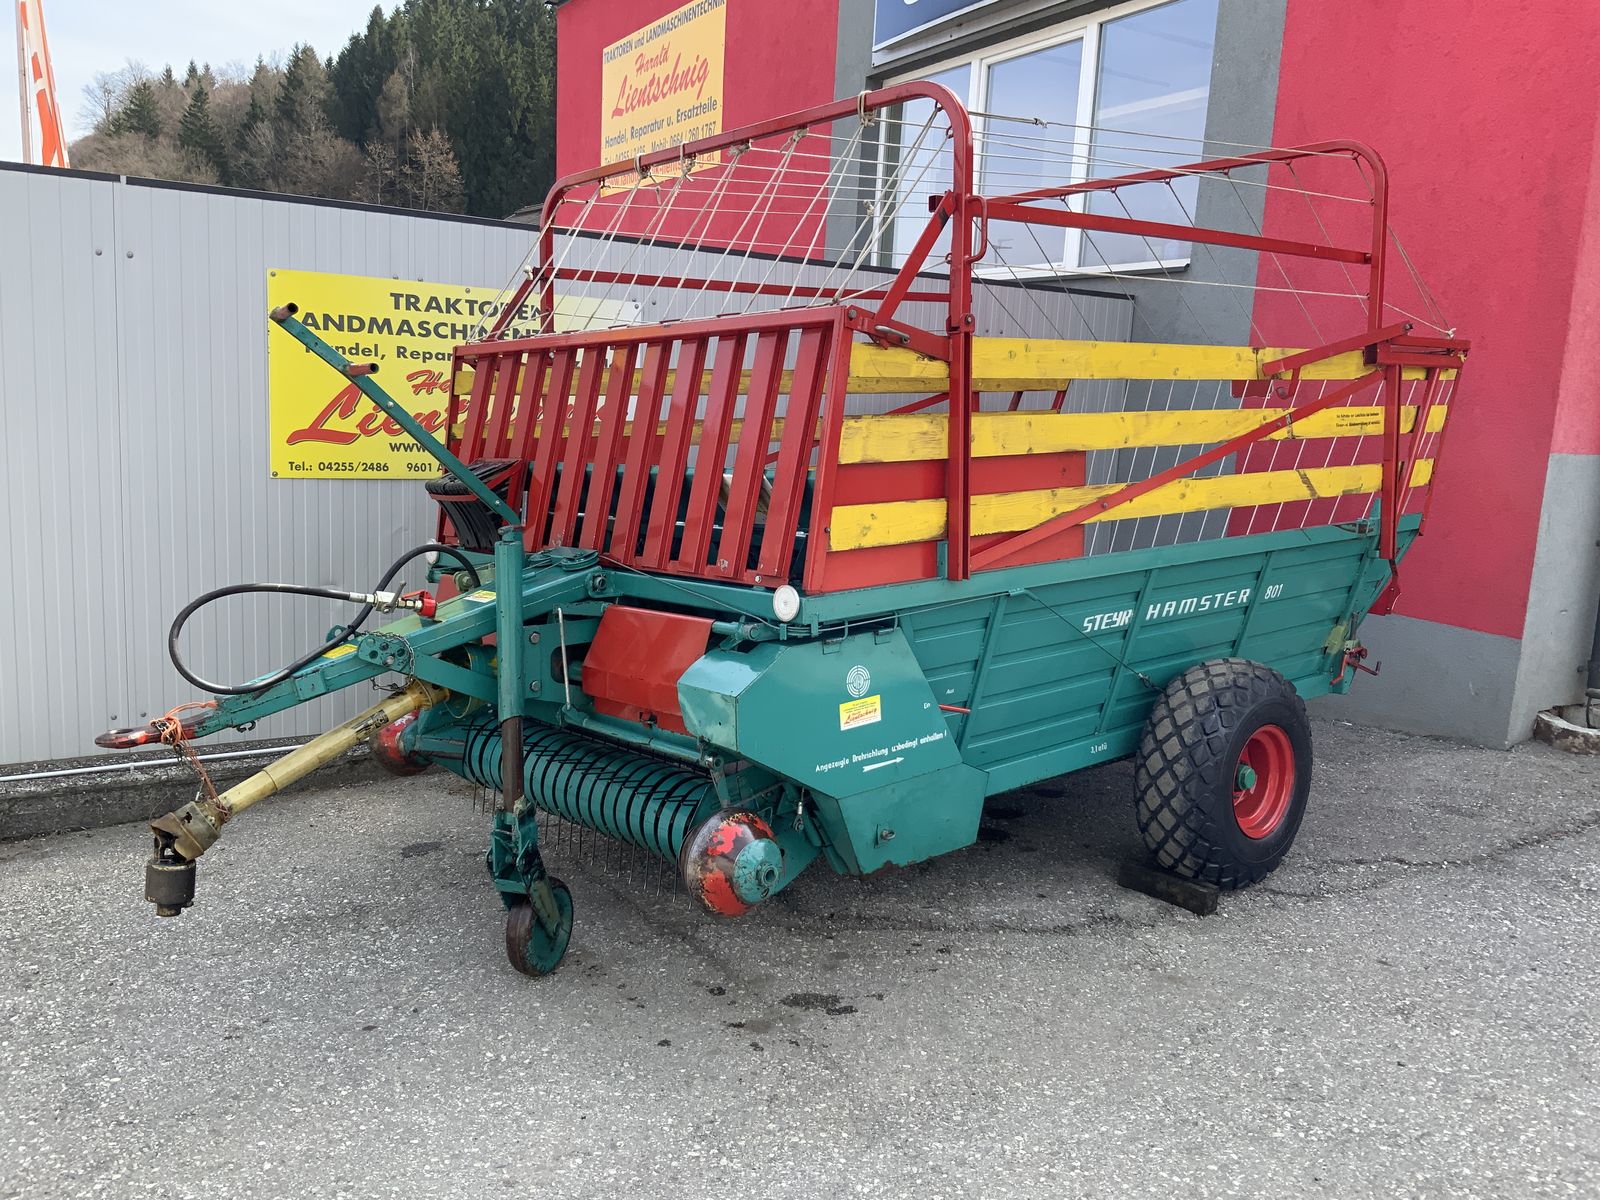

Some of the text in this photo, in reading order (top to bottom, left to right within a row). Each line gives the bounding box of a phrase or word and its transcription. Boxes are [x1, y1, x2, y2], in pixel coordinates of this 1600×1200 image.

[603, 38, 634, 64] TRAKTOREN
[634, 32, 645, 50] und
[634, 41, 671, 77] Harald
[610, 52, 710, 119] Lientschnig
[604, 96, 718, 149] Handel, Reparatur u. Ersatzteile
[288, 461, 313, 472] Tel.:
[317, 461, 389, 473] 04255/2486
[406, 462, 433, 473] 9601
[1082, 583, 1284, 633] STEYR HAMSTER 801
